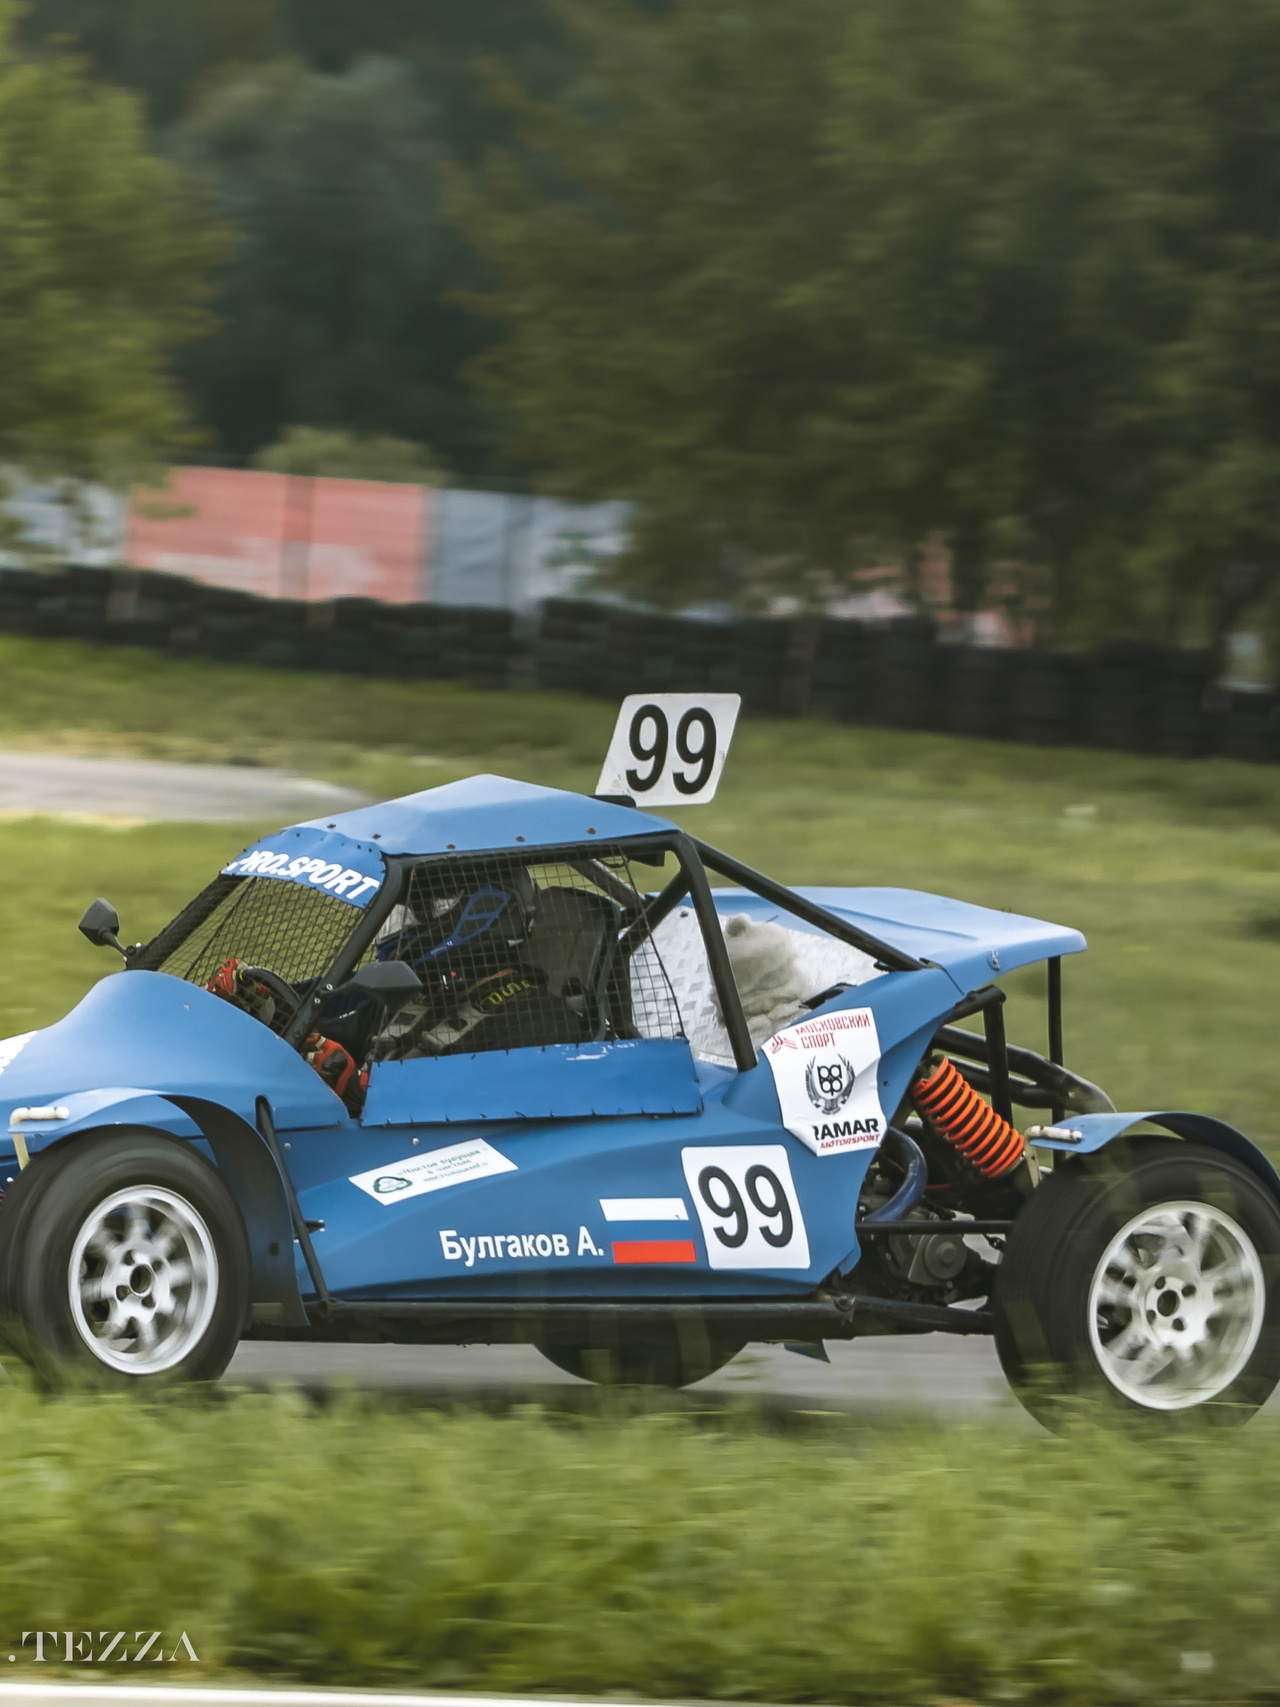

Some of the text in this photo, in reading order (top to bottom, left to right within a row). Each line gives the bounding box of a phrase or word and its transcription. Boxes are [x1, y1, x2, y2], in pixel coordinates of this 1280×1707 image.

[625, 704, 717, 795] 99
[795, 1012, 871, 1035] МОСКОВСКИЙ
[800, 1032, 836, 1049] СПОРТ
[820, 1134, 880, 1149] MOTORSPORT
[698, 1163, 794, 1249] 99
[439, 1226, 605, 1267] Булгаков А.
